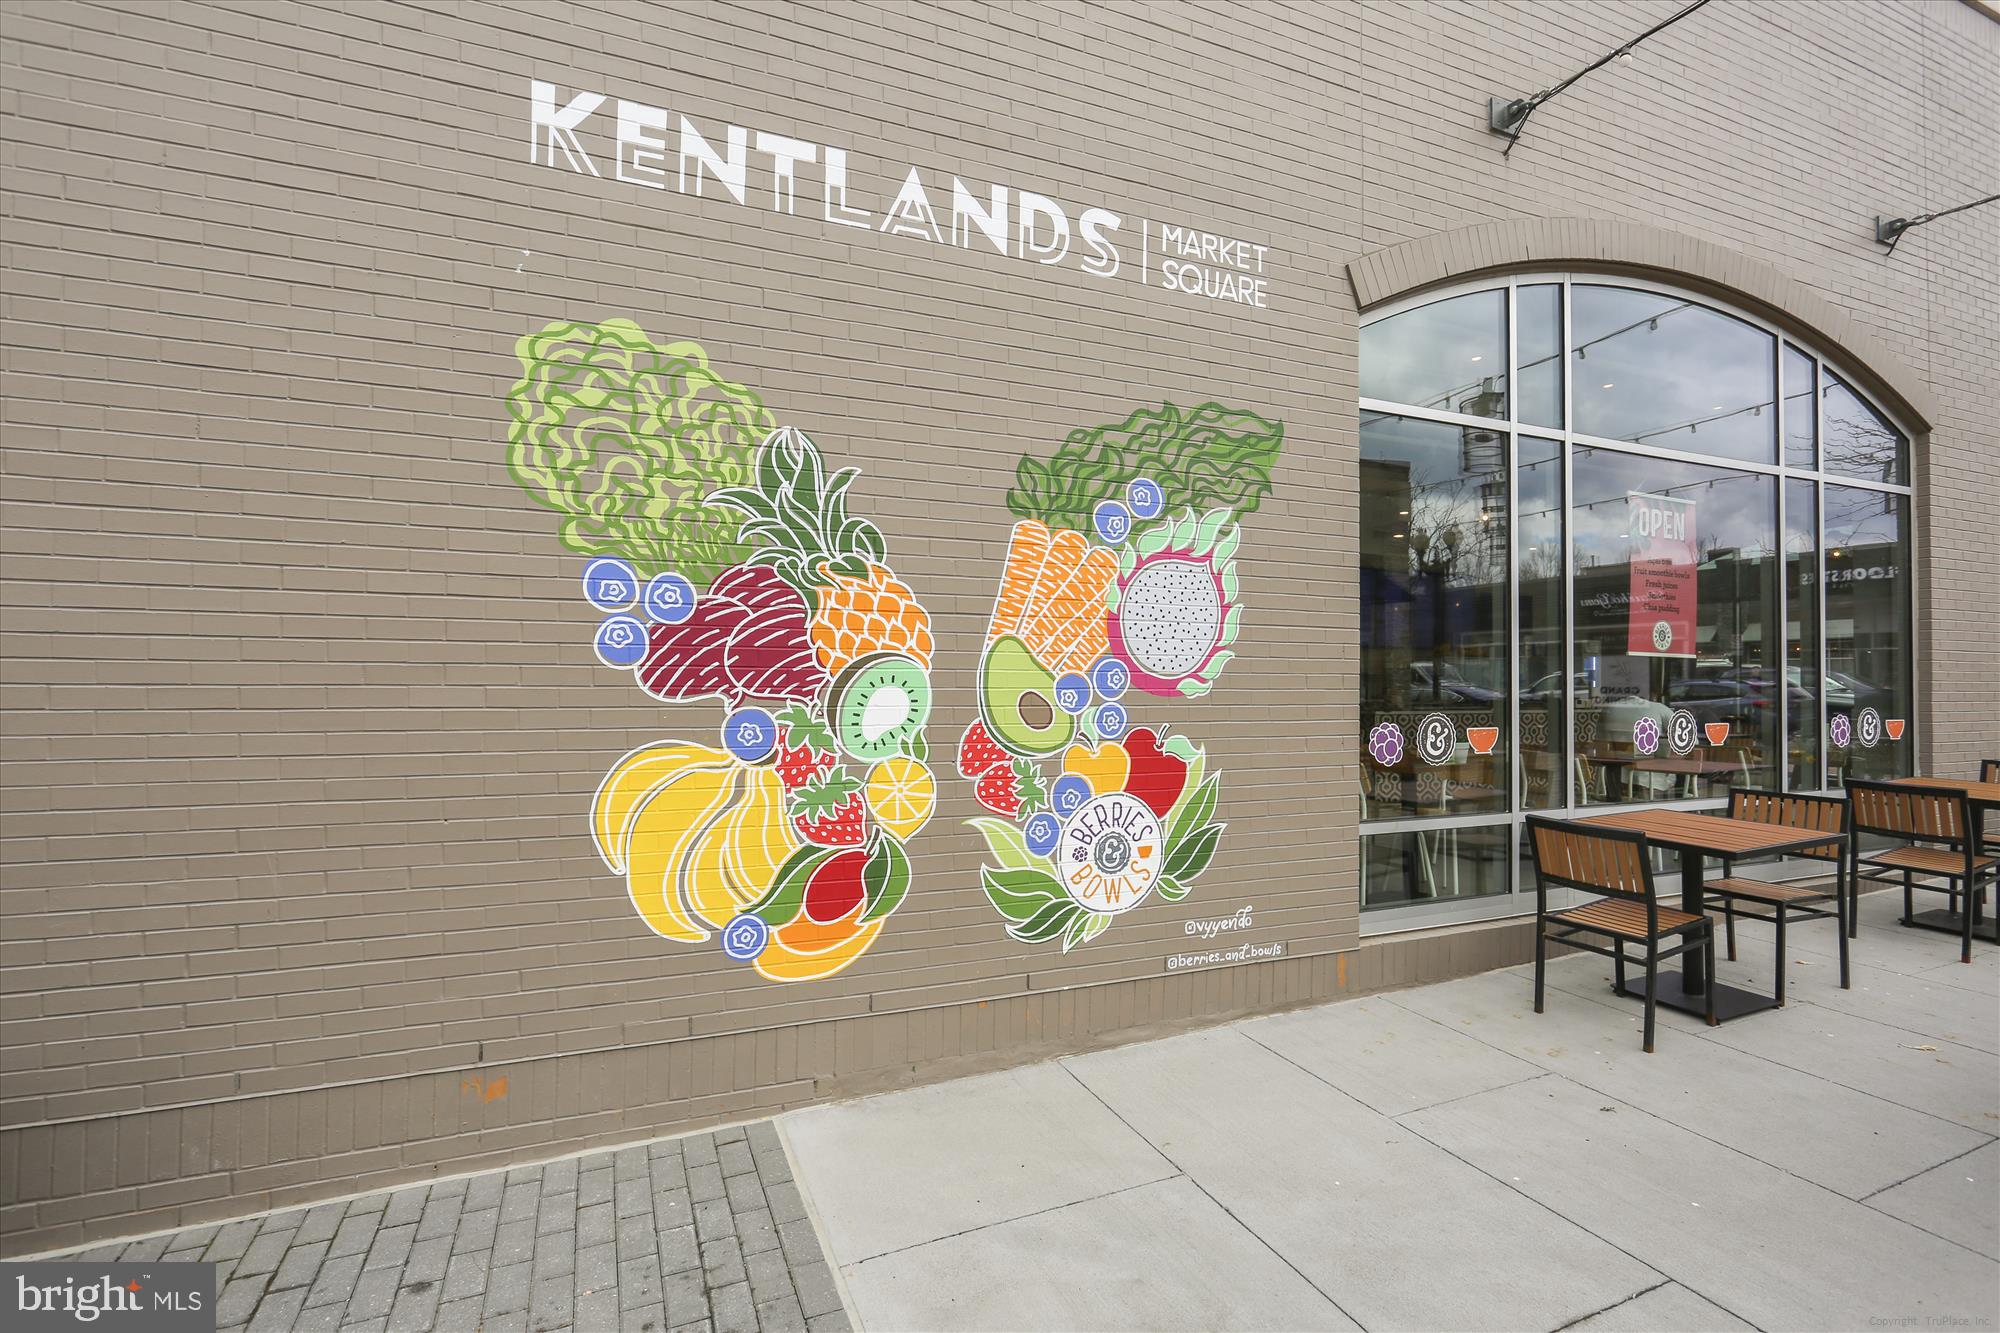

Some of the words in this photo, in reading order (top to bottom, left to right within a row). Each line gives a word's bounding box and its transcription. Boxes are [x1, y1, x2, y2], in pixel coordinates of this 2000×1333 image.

[530, 79, 1122, 278] KENTLANDS
[1161, 224, 1268, 273] MARKET
[1161, 260, 1268, 308] SQUARE
[1638, 507, 1686, 541] OPEN
[1070, 802, 1153, 846] BERRIES
[1070, 860, 1151, 904] BOWLS
[1184, 905, 1253, 939] @vyyendo
[1167, 943, 1282, 969] @berries_and_bowls
